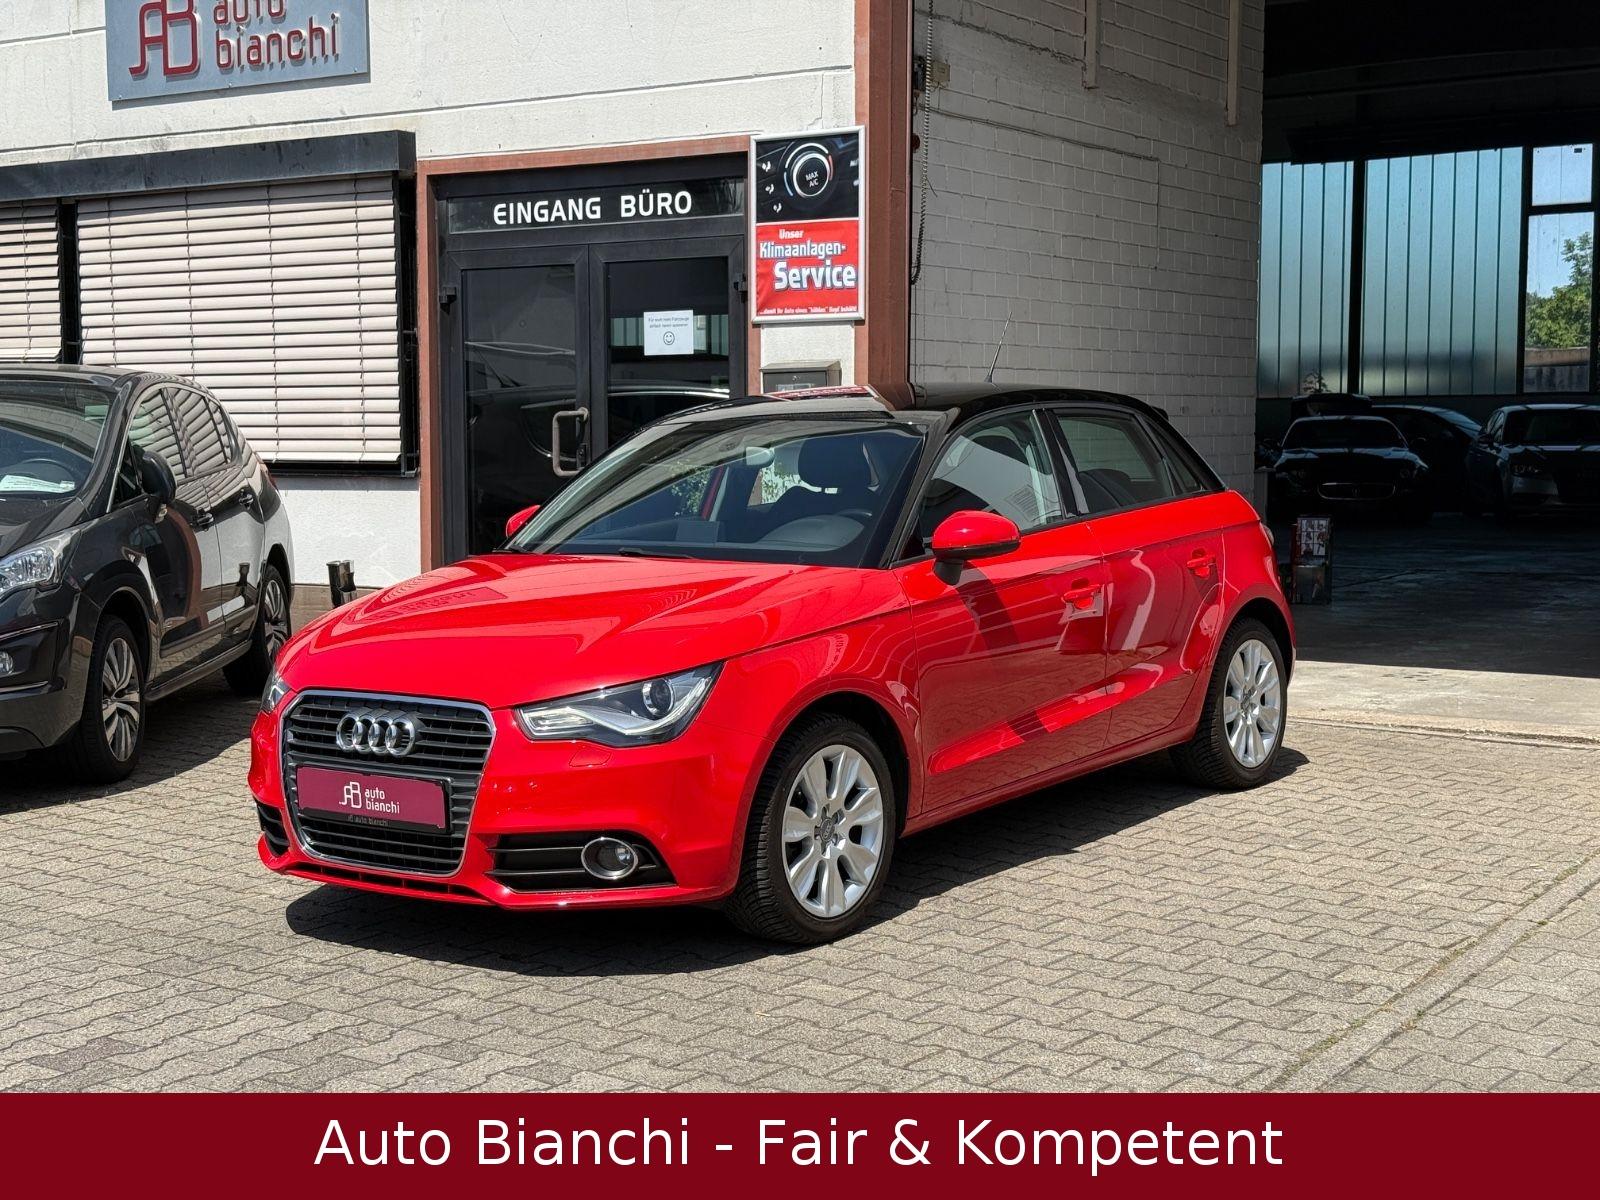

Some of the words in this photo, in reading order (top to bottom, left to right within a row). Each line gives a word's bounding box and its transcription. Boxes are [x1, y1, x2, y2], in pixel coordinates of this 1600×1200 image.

[216, 12, 337, 69] bianchi
[805, 171, 819, 181] MAX
[493, 197, 601, 225] EINGANG
[620, 188, 692, 218] BÜRO
[779, 229, 804, 239] Unser
[760, 239, 846, 259] Klimaanlagen-
[774, 260, 856, 290] Service
[365, 787, 385, 799] auto
[366, 798, 400, 814] bianchi
